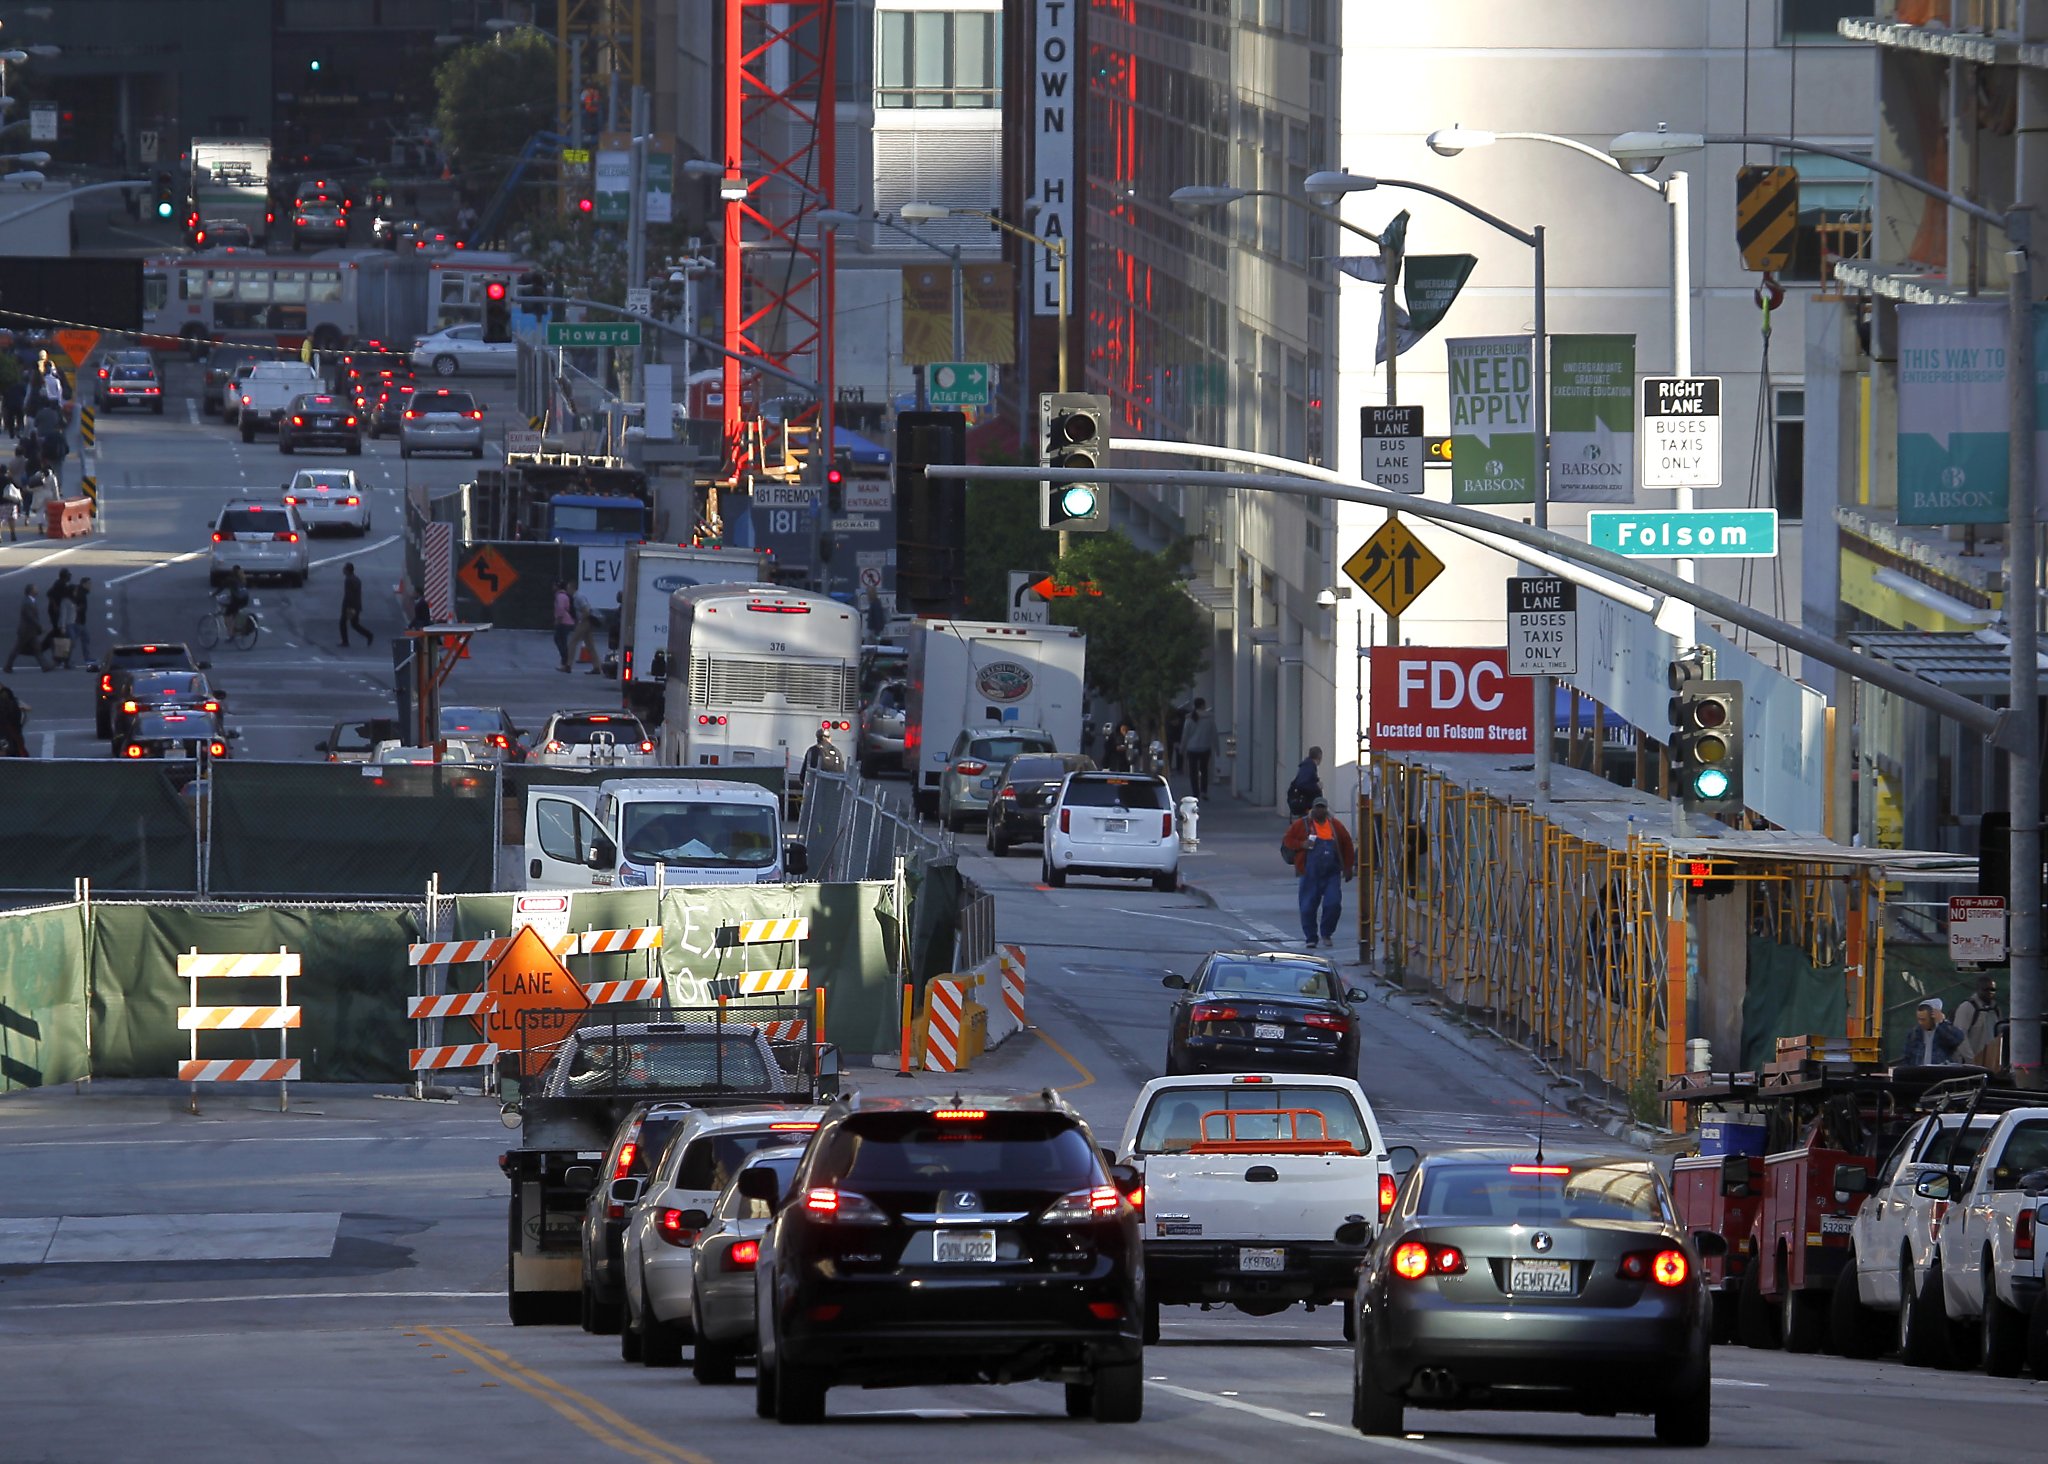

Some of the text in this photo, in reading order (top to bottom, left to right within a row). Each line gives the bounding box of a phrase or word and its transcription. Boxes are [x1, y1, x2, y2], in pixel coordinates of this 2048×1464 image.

[1041, 2, 1068, 308] TOWN HALL
[630, 303, 648, 315] 25
[559, 328, 629, 341] Howard
[1451, 342, 1529, 357] ENTREPRENEURS
[1903, 349, 2006, 369] THIS WAY TO
[1563, 362, 1623, 373] UNDERGRADUATE
[1452, 356, 1530, 395] NEED
[1575, 374, 1611, 384] GRADUATE
[1903, 370, 2006, 384] ENTREPRENEURSHIP
[1553, 386, 1632, 397] EXECUTIVE EDUCATION
[1658, 382, 1705, 398] RIGHT
[932, 392, 985, 402] AT&T Park
[1454, 394, 1530, 426] APPLY
[1660, 399, 1704, 414] LANE
[1373, 409, 1411, 422] RIGHT
[1375, 423, 1410, 435] LANE
[1656, 421, 1707, 434] BUSES
[1380, 440, 1406, 451] BUS
[1660, 439, 1704, 451] TAXIS
[1376, 456, 1409, 468] LANE
[1662, 456, 1701, 470] ONLY
[1561, 462, 1623, 476] BABSON
[1376, 473, 1409, 485] ENDS
[1464, 478, 1526, 492] BABSON
[858, 484, 880, 493] MAIN
[755, 489, 771, 503] 181
[1913, 491, 1994, 509] BABSON
[847, 498, 889, 508] ENTRANCE
[769, 510, 797, 533] 181
[1618, 522, 1748, 546] Folsom
[1521, 581, 1563, 594] RIGHT
[1523, 596, 1561, 609] LANE
[1013, 611, 1043, 622] ONLY
[1520, 614, 1567, 627] BUSES
[1523, 630, 1564, 643] TAXIS
[770, 642, 786, 652] 376
[1525, 646, 1562, 660] ONLY
[1398, 660, 1505, 712] FDC
[1376, 722, 1528, 741] Located on Folsom Street
[1955, 899, 2000, 907] TOW-AWAY
[1950, 907, 2003, 920] NO STOPPING
[1952, 934, 1971, 945] 3PM
[1982, 934, 2001, 945] 7PM
[502, 972, 553, 995] LANE
[489, 1007, 565, 1031] CLOSED
[1513, 1272, 1568, 1288] 6EWR724
